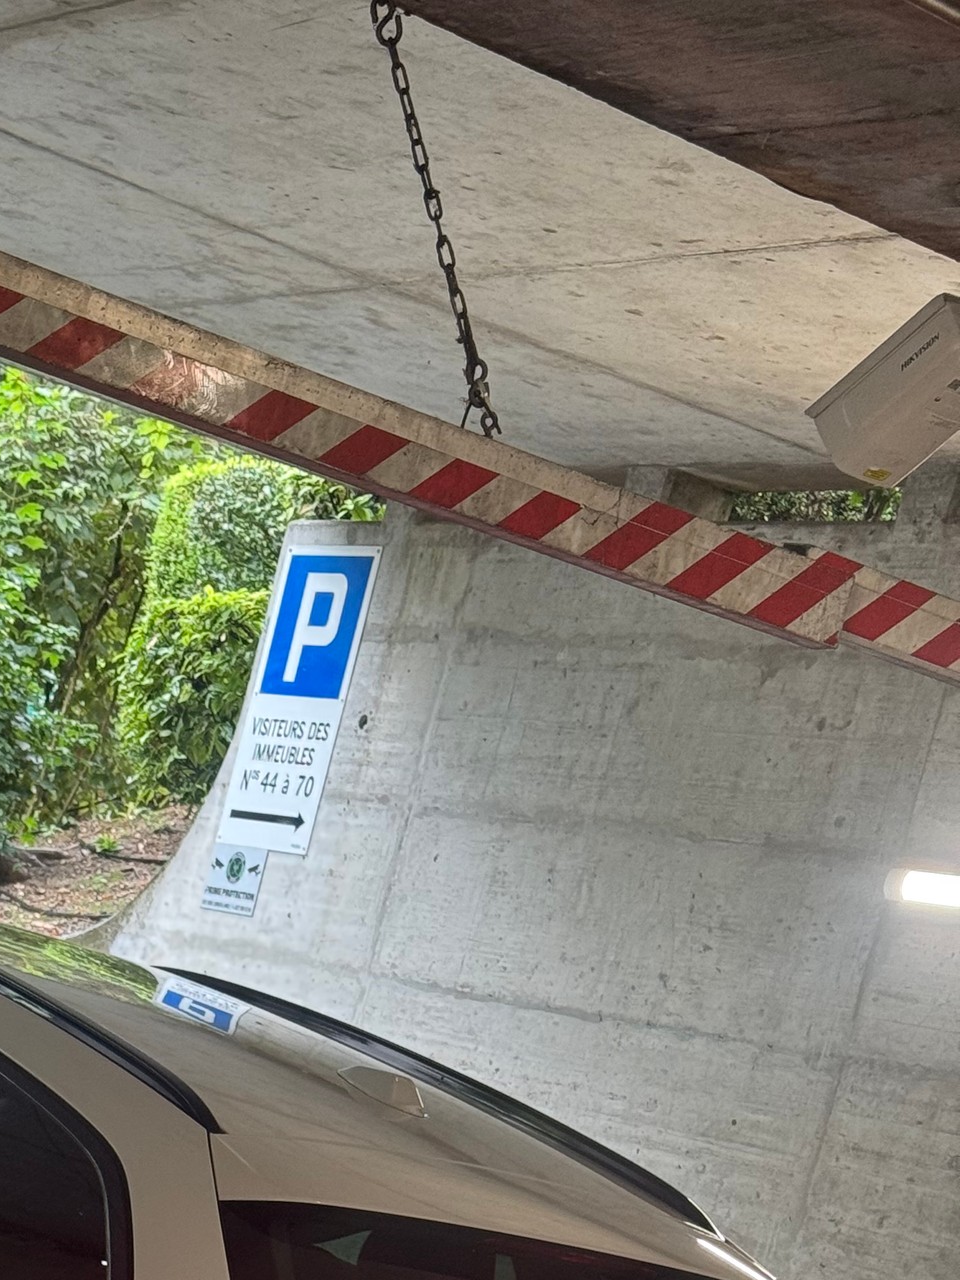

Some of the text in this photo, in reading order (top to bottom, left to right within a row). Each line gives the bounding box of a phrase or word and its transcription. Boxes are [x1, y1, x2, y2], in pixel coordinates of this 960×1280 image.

[900, 332, 940, 372] HIKVISION
[282, 572, 348, 683] P
[252, 717, 331, 741] VISITEURS DES
[252, 743, 315, 766] IMMEUBLES
[260, 771, 278, 794] 44
[281, 773, 290, 795] à
[295, 775, 315, 797] 70
